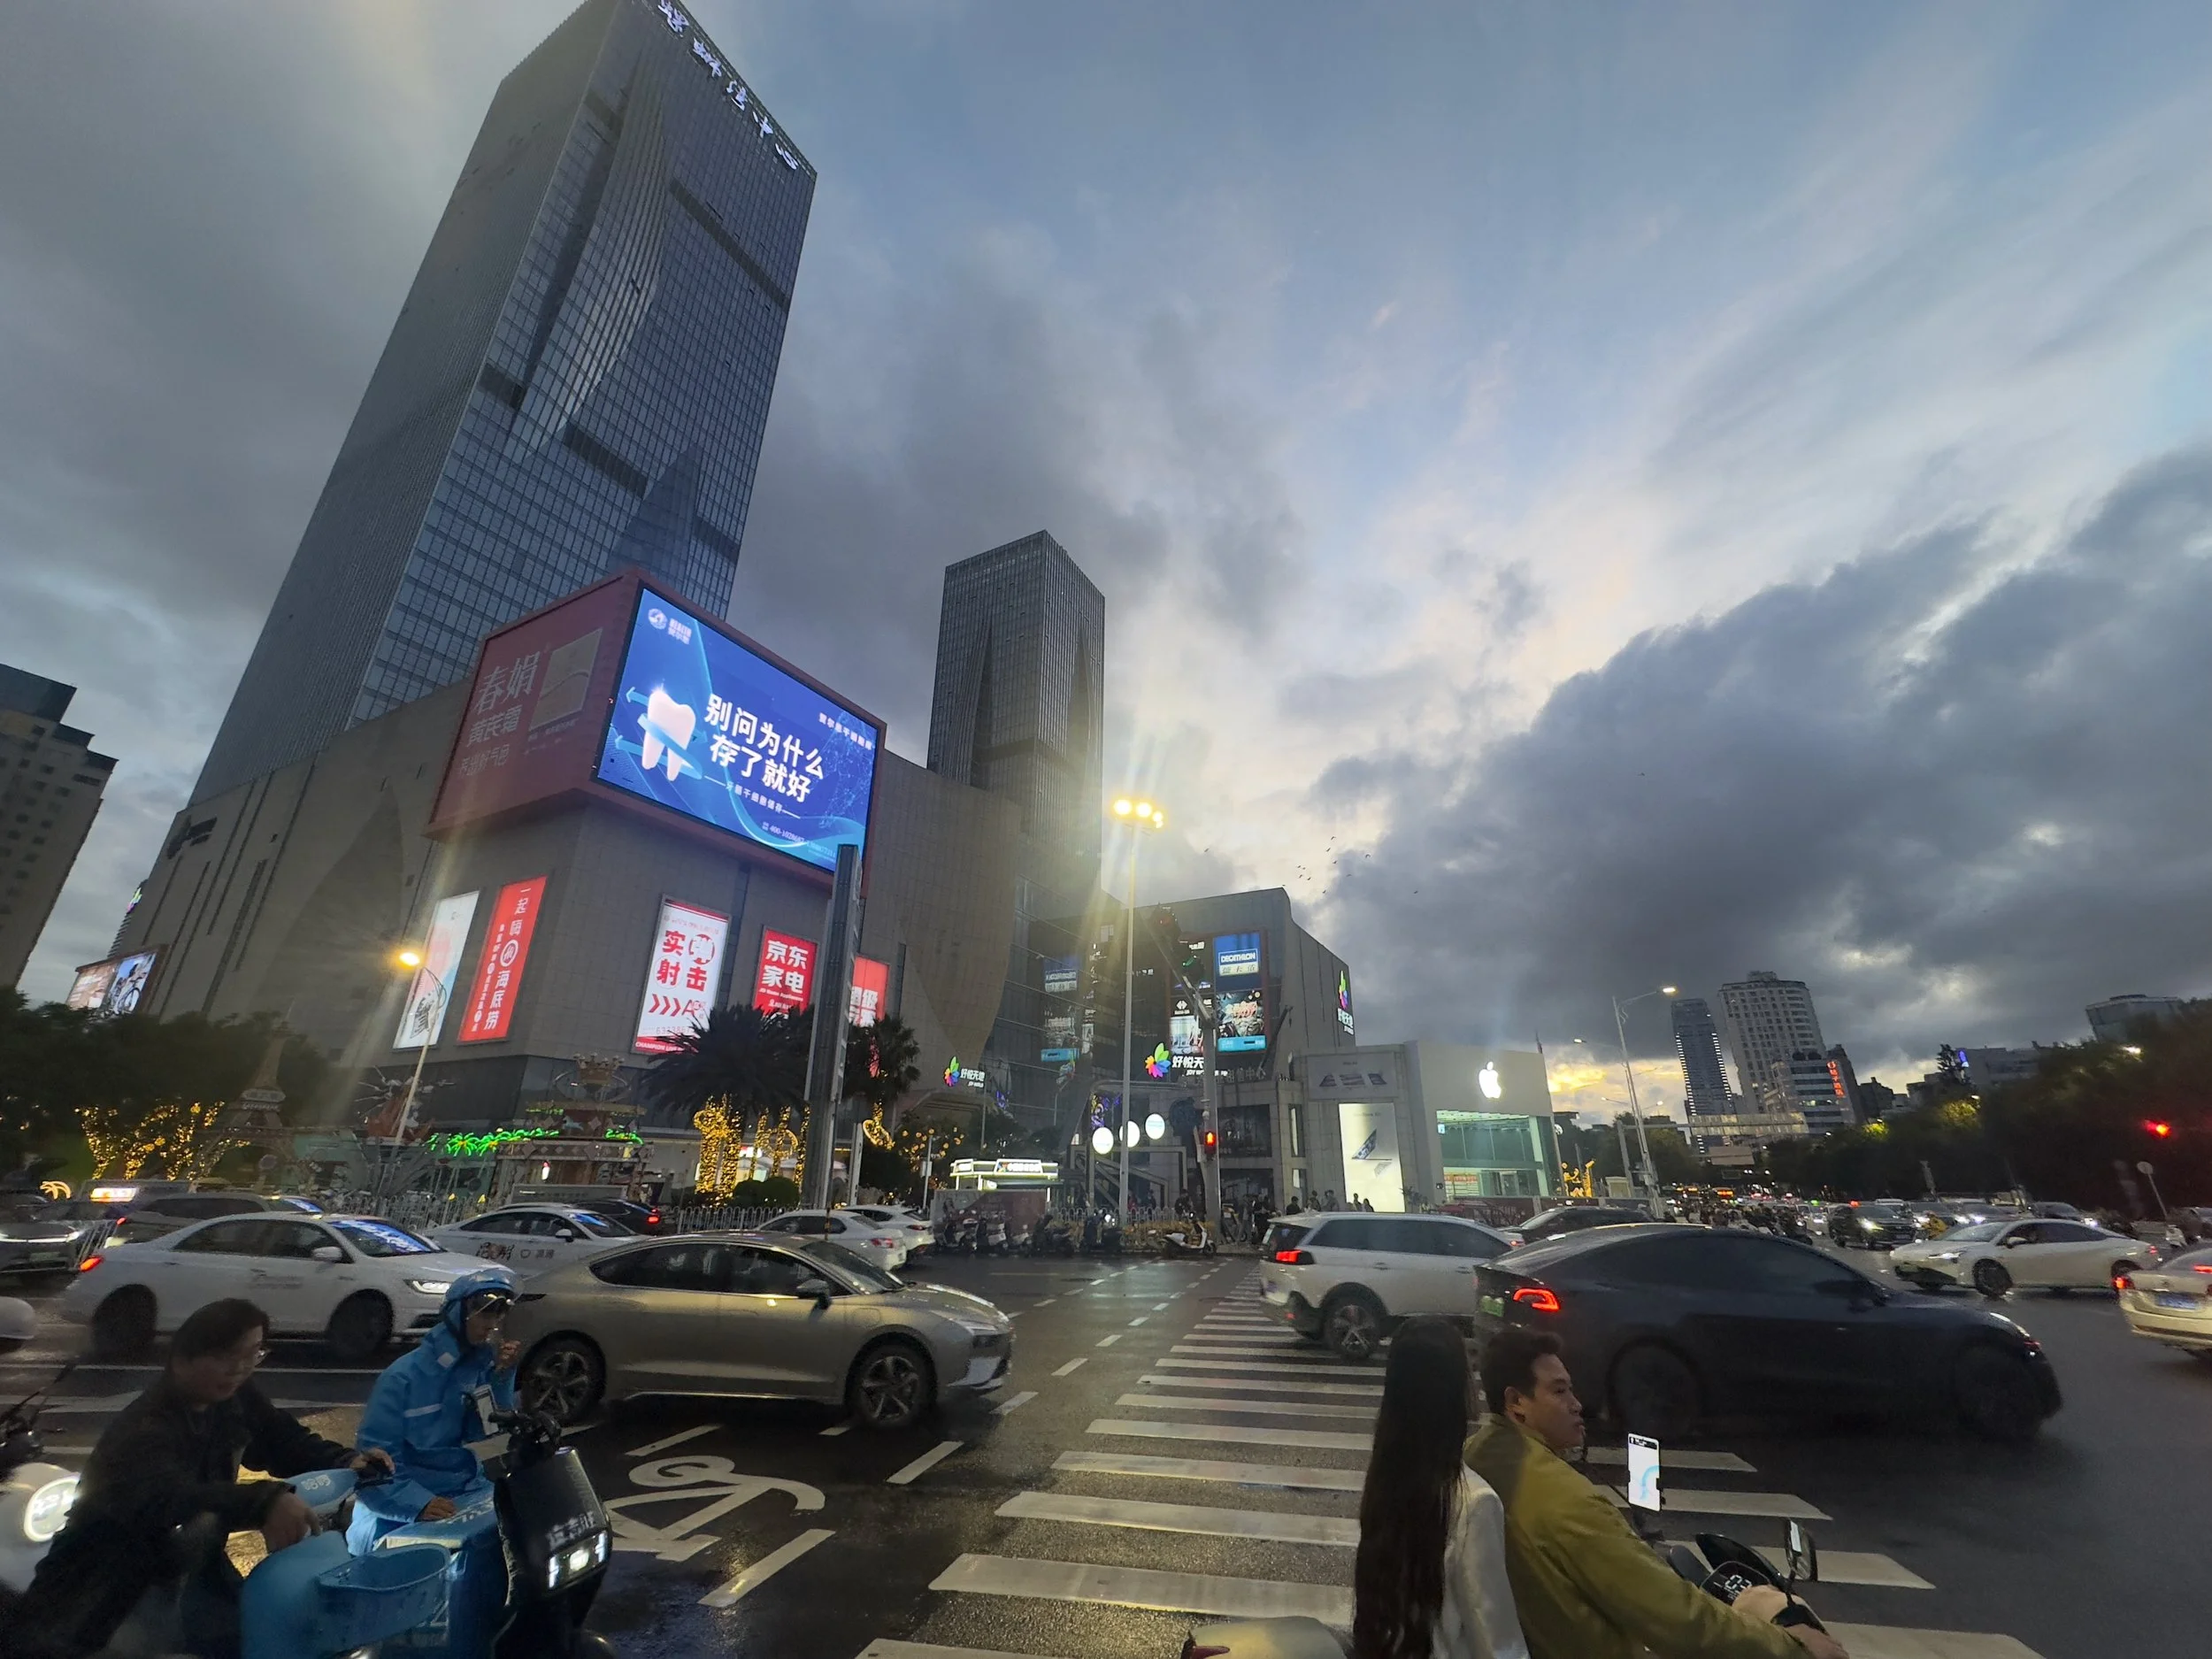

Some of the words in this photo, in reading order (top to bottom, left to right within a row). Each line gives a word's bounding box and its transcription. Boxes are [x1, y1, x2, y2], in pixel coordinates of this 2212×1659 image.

[473, 650, 541, 715] 春娟
[703, 693, 824, 780] 别问为什么
[710, 733, 811, 803] 存了就好
[764, 940, 809, 970] 京东
[1220, 952, 1256, 963] DECATHLON
[656, 958, 708, 992] 射击
[761, 964, 804, 994] 家电
[484, 970, 511, 1031] 海底捞
[635, 1041, 665, 1051] CHAMPION
[960, 1068, 986, 1081] 好悦天地
[1171, 1055, 1204, 1069] 好悦天
